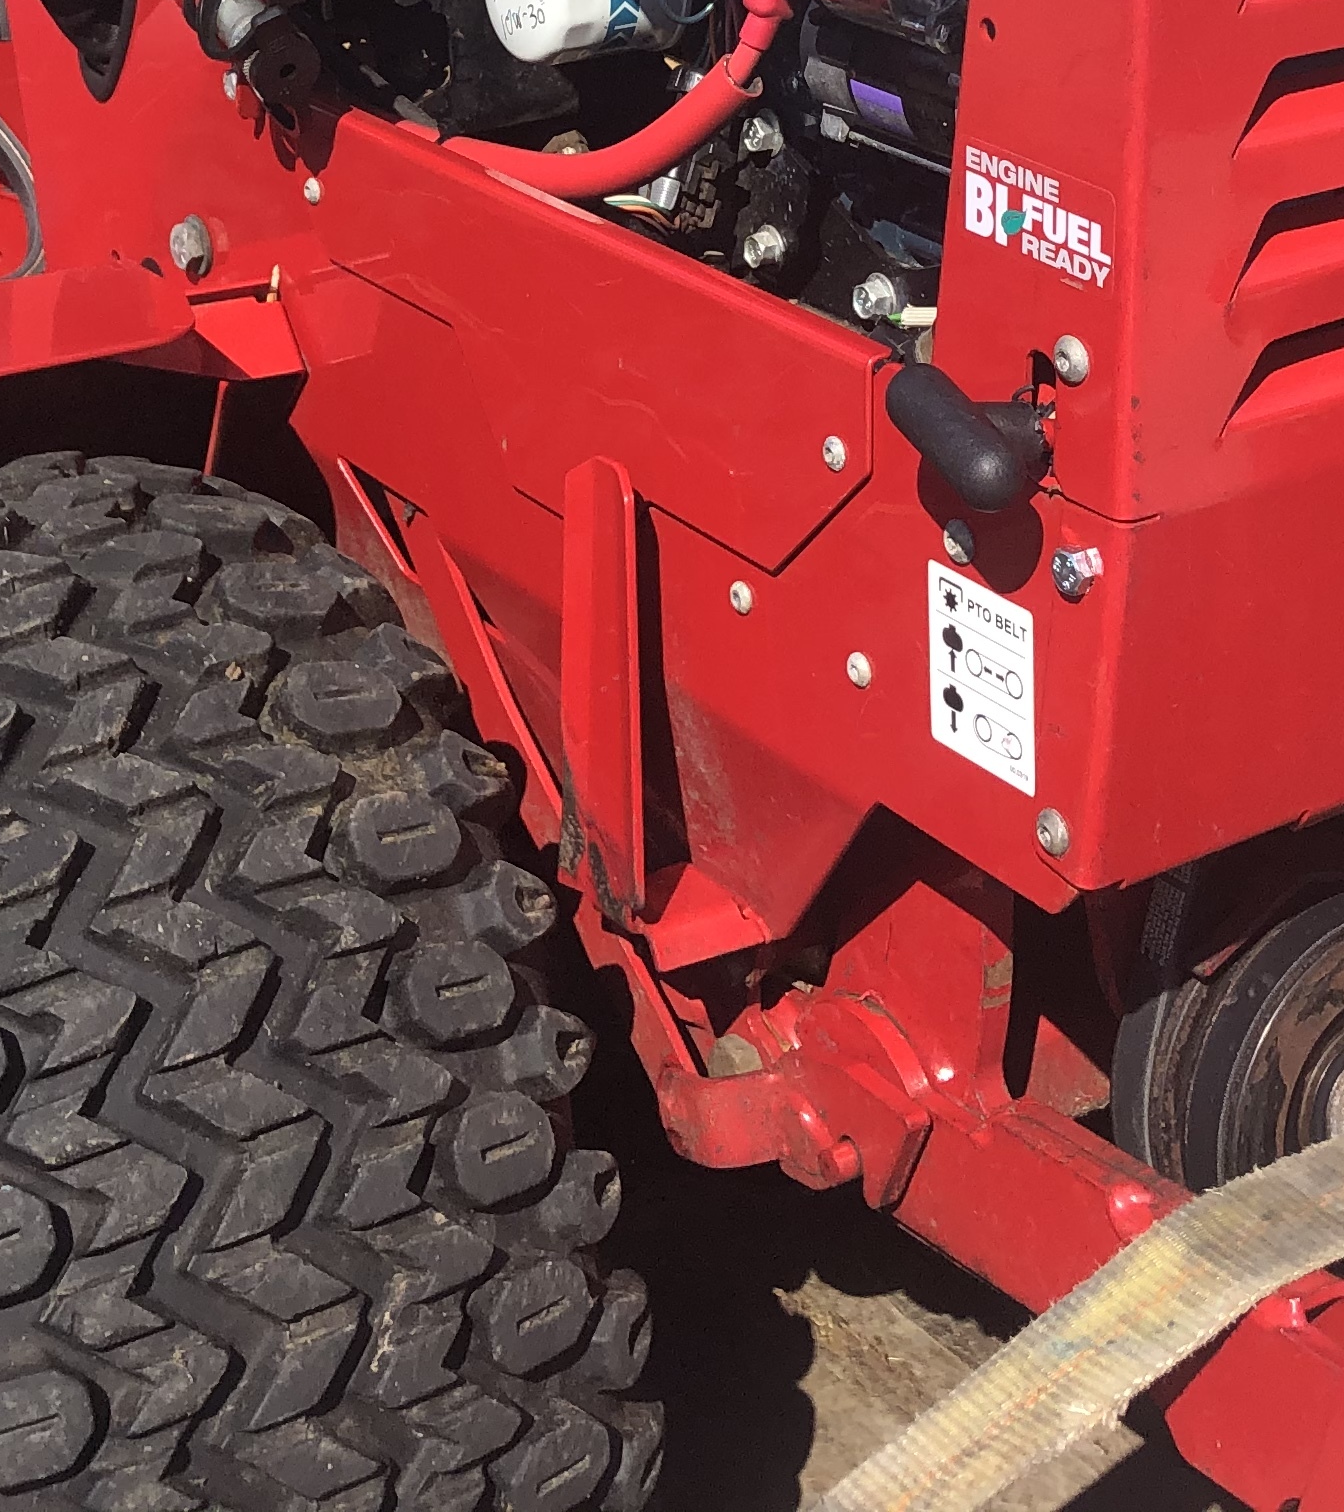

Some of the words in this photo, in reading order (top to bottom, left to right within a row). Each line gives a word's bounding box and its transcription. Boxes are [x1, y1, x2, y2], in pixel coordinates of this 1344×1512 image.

[965, 144, 1060, 204] ENGINE
[1021, 231, 1111, 289] READY
[967, 598, 992, 624] PTO
[995, 612, 1028, 643] BELT
